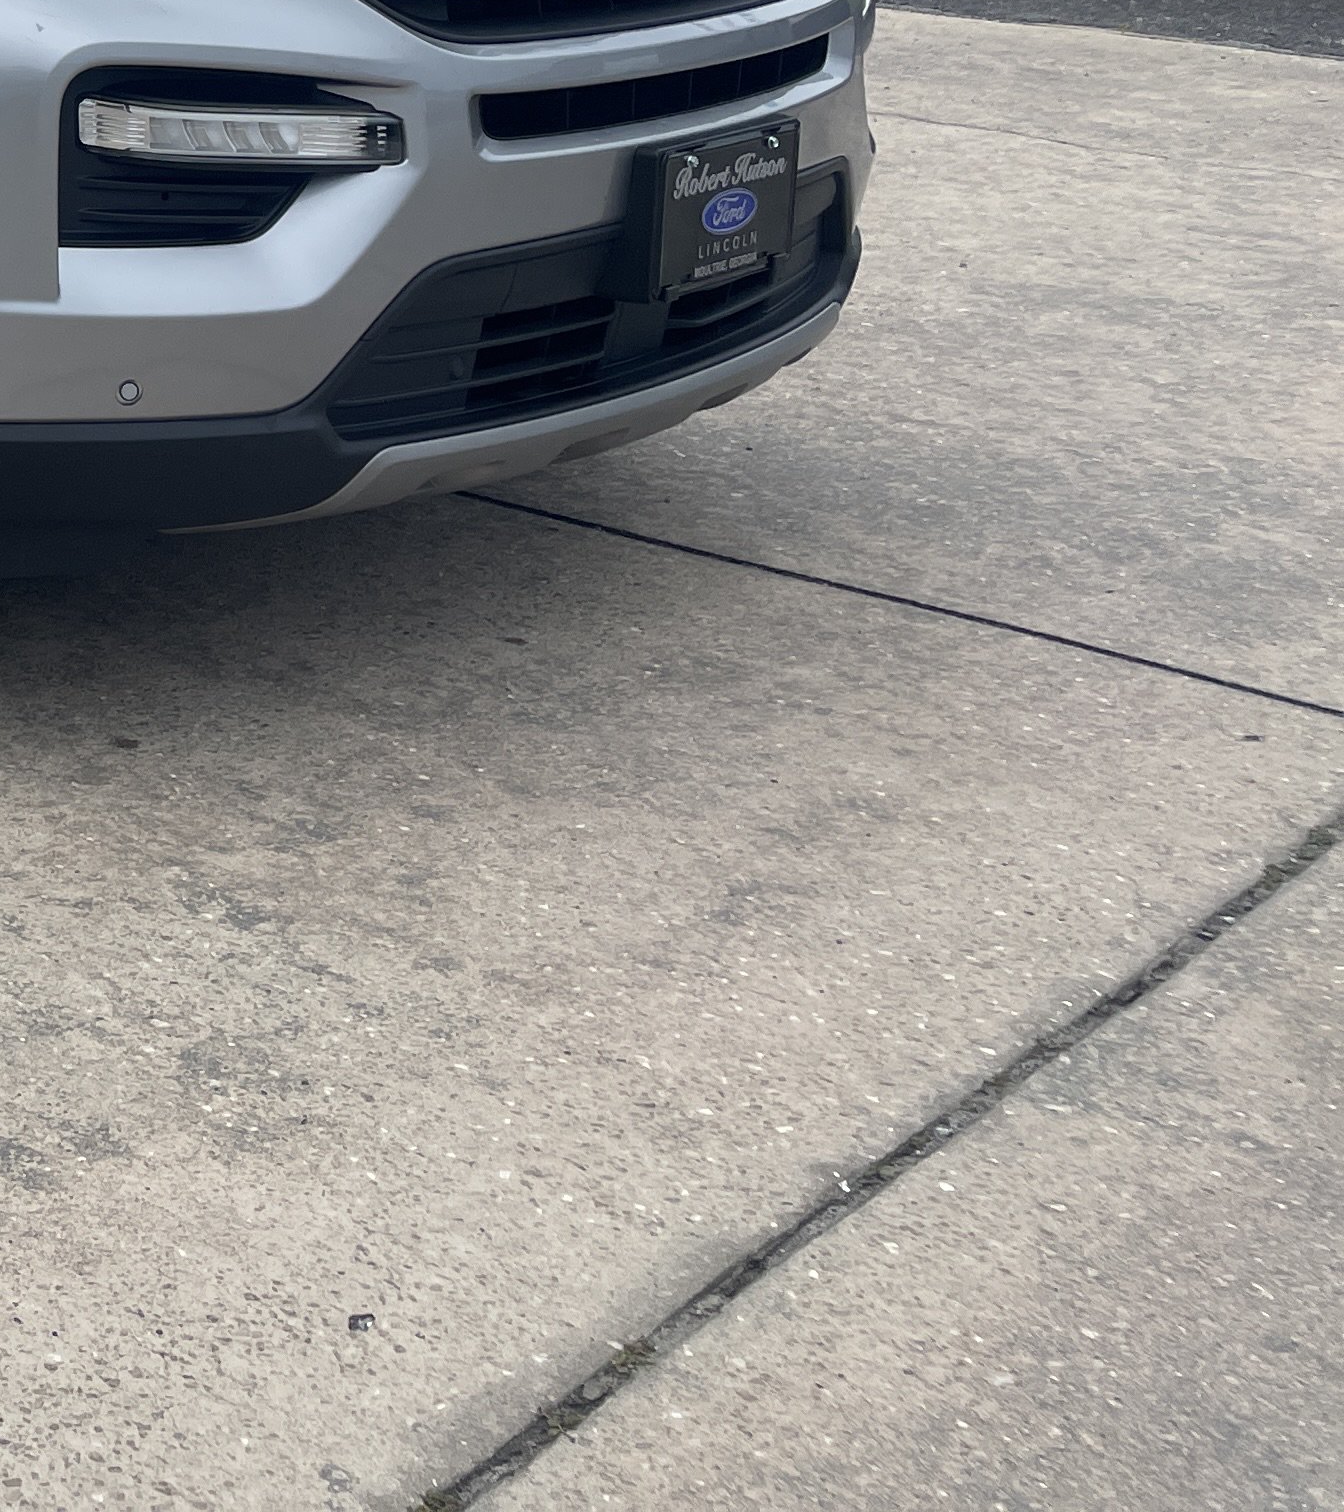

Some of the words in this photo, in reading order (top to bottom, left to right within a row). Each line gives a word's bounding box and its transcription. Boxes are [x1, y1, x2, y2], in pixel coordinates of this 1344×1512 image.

[673, 162, 732, 200] Robert
[732, 153, 787, 185] Hutson
[712, 196, 748, 226] Ford
[698, 231, 758, 259] LINCOLN
